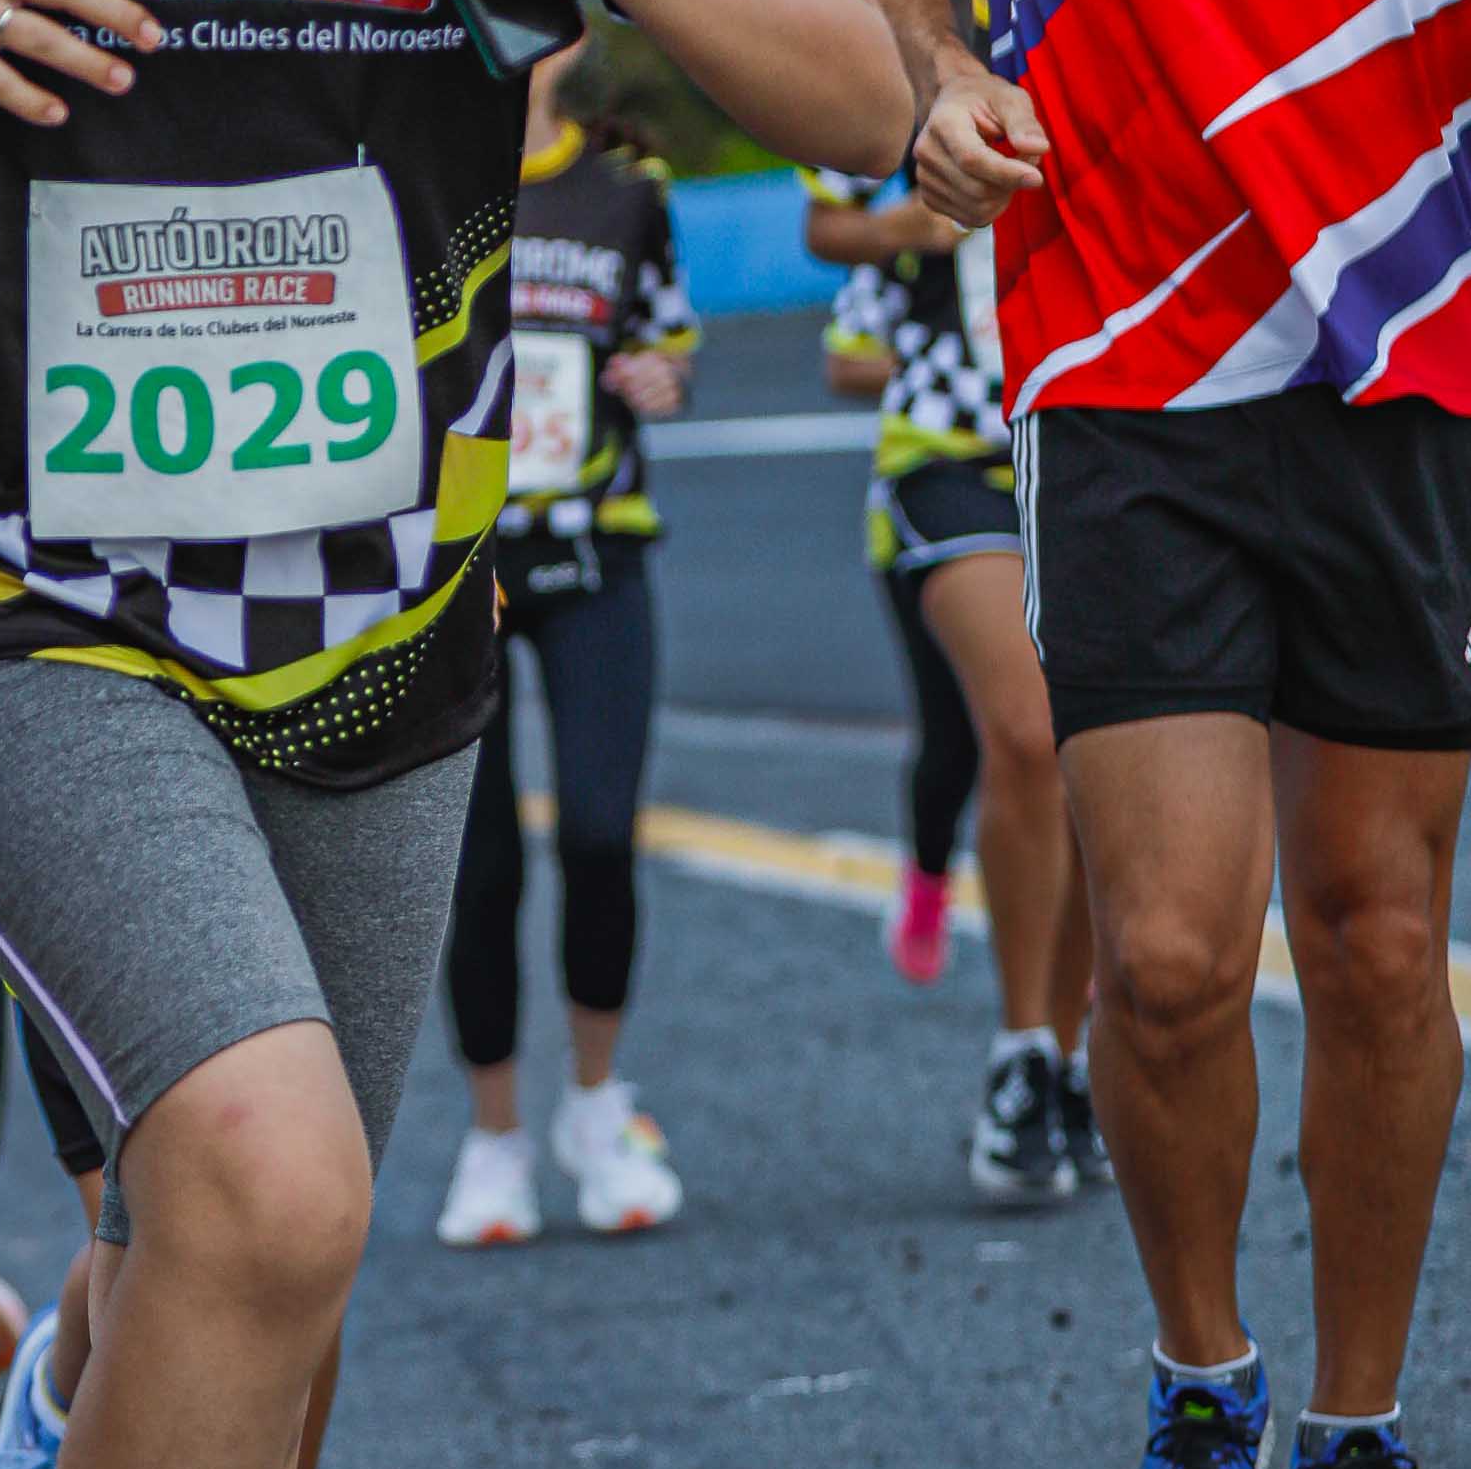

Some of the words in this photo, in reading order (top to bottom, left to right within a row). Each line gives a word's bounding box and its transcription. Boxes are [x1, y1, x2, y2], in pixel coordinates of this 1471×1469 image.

[191, 20, 290, 51] Clubes
[296, 20, 342, 51] del
[349, 22, 466, 51] Noroeste
[80, 206, 349, 279] AUTÓDROMO
[121, 278, 237, 312] RUNNING
[243, 276, 310, 305] RACE
[76, 322, 93, 337] La
[96, 322, 153, 338] Carrera
[157, 322, 176, 337] de
[180, 321, 203, 337] los
[207, 319, 259, 336] Clubes
[263, 316, 287, 332] del
[290, 310, 357, 329] Noroeste
[45, 350, 397, 476] 2029
